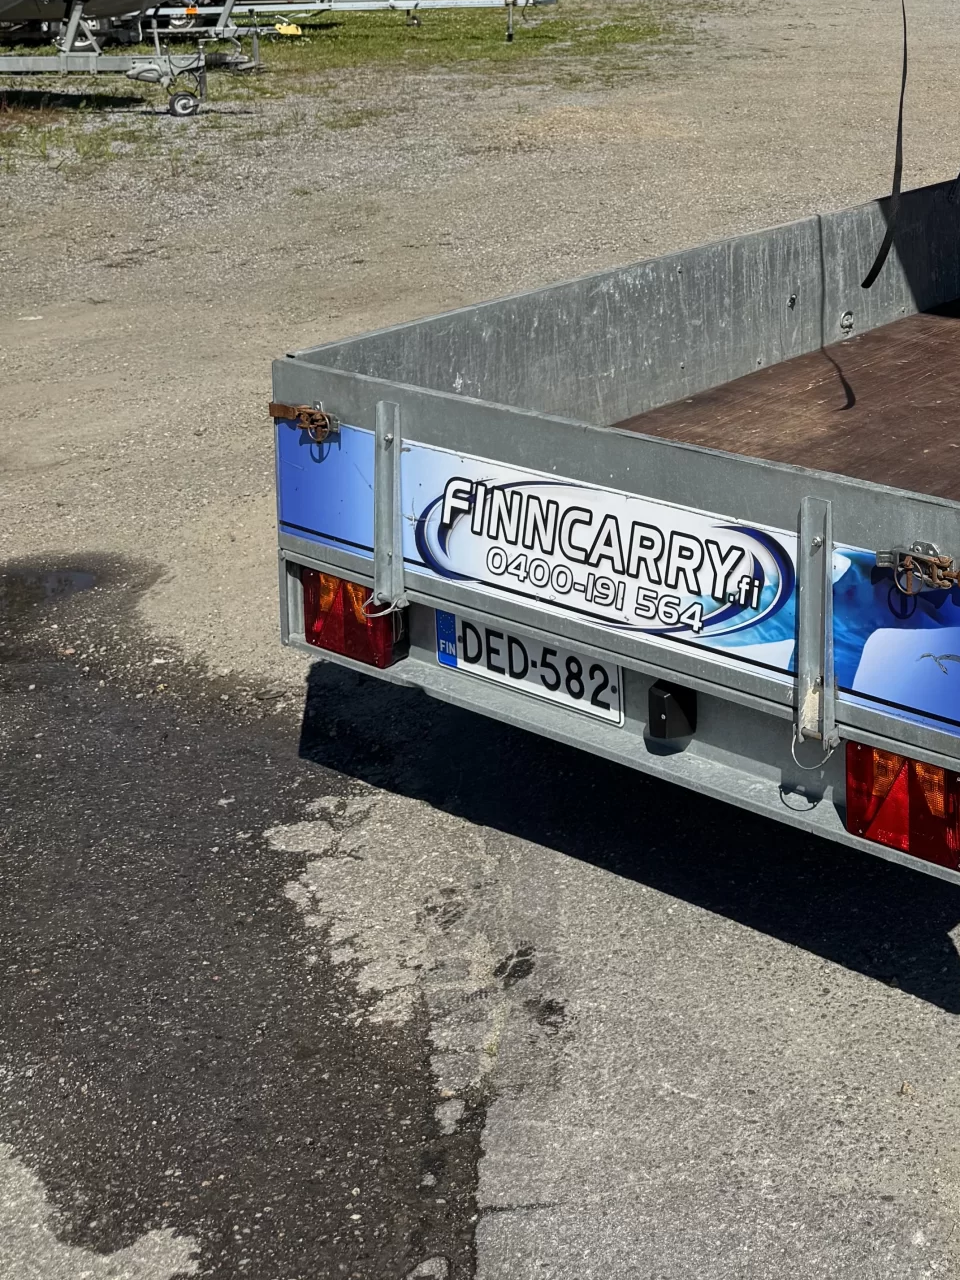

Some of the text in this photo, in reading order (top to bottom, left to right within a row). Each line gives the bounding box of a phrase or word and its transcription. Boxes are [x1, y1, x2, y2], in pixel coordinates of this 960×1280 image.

[441, 477, 765, 609] FINNCARRY.fi
[486, 546, 704, 634] 0400-191 564
[440, 640, 456, 656] FIN
[461, 620, 611, 711] DED-582
